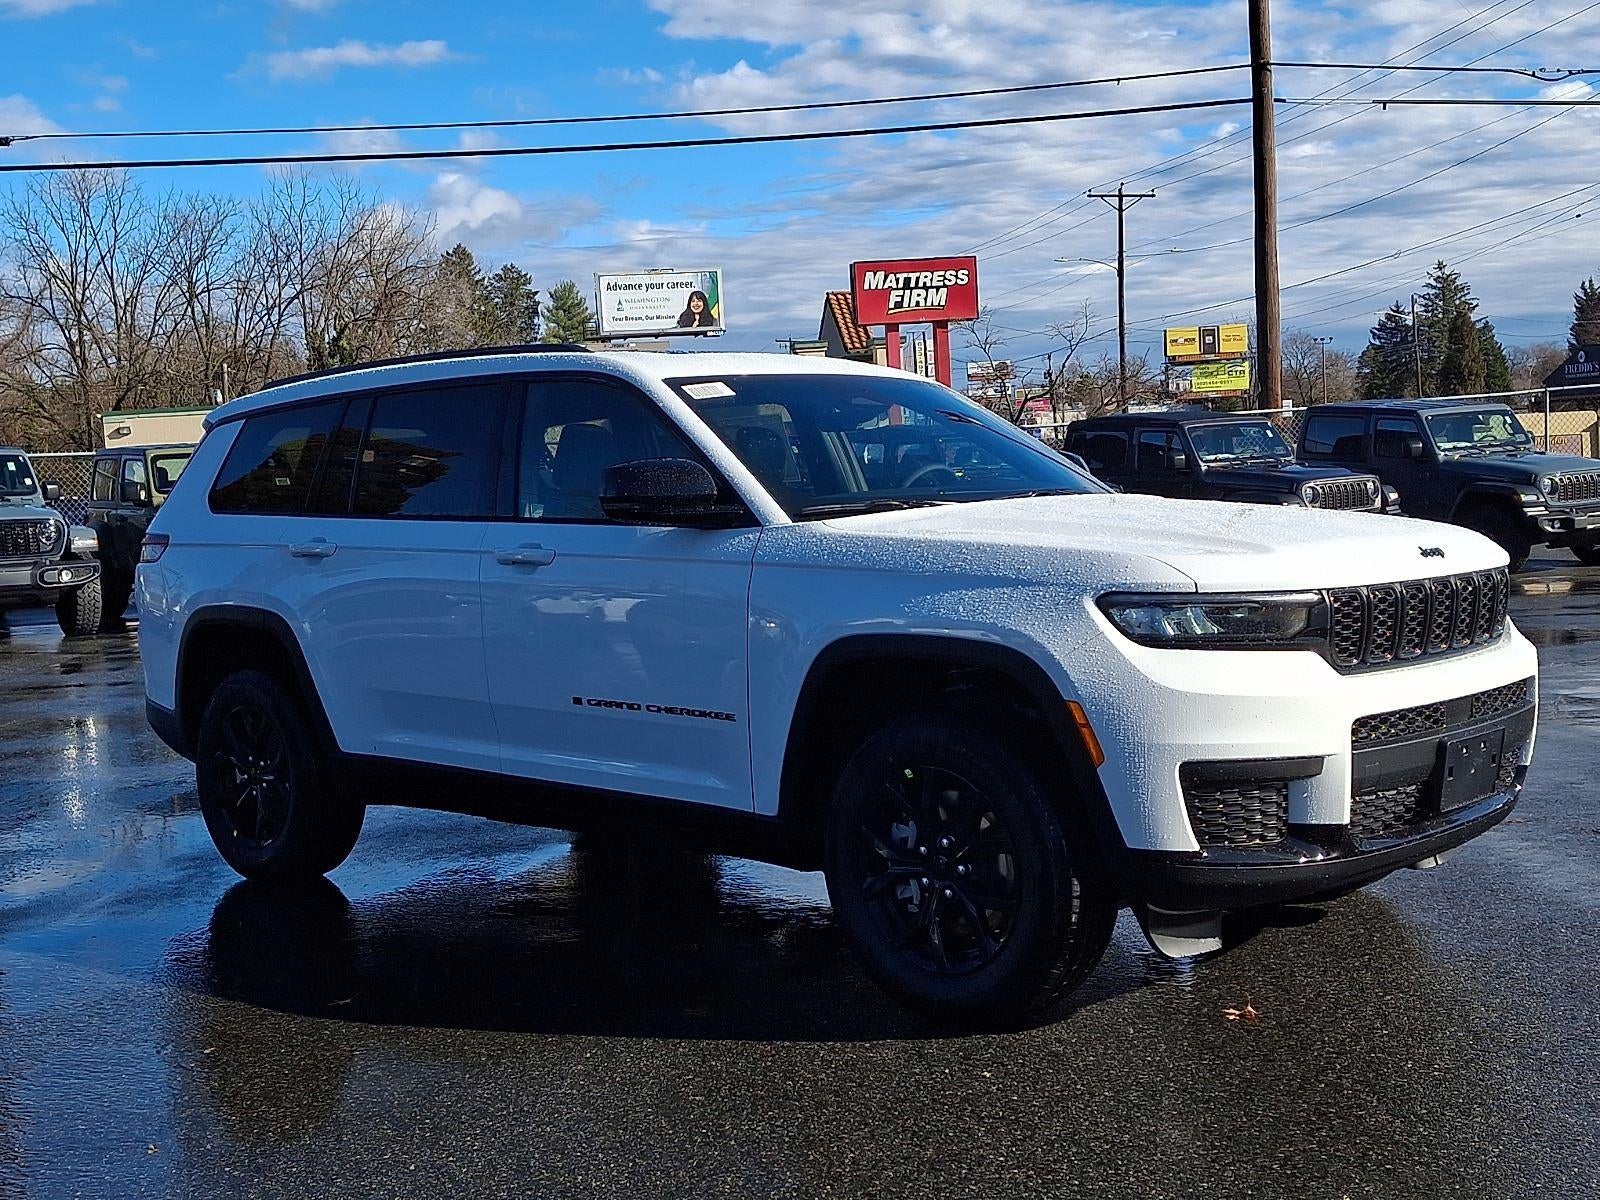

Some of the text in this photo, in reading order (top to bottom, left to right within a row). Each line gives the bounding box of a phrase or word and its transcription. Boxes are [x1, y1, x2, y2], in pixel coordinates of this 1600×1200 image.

[606, 280, 696, 293] Advance your career.
[863, 269, 969, 290] MATTRESS
[624, 296, 671, 304] WILMINGTON
[888, 287, 948, 309] FIRM
[1418, 546, 1445, 559] Jeep
[586, 698, 737, 722] GRAND CHEROKEE
